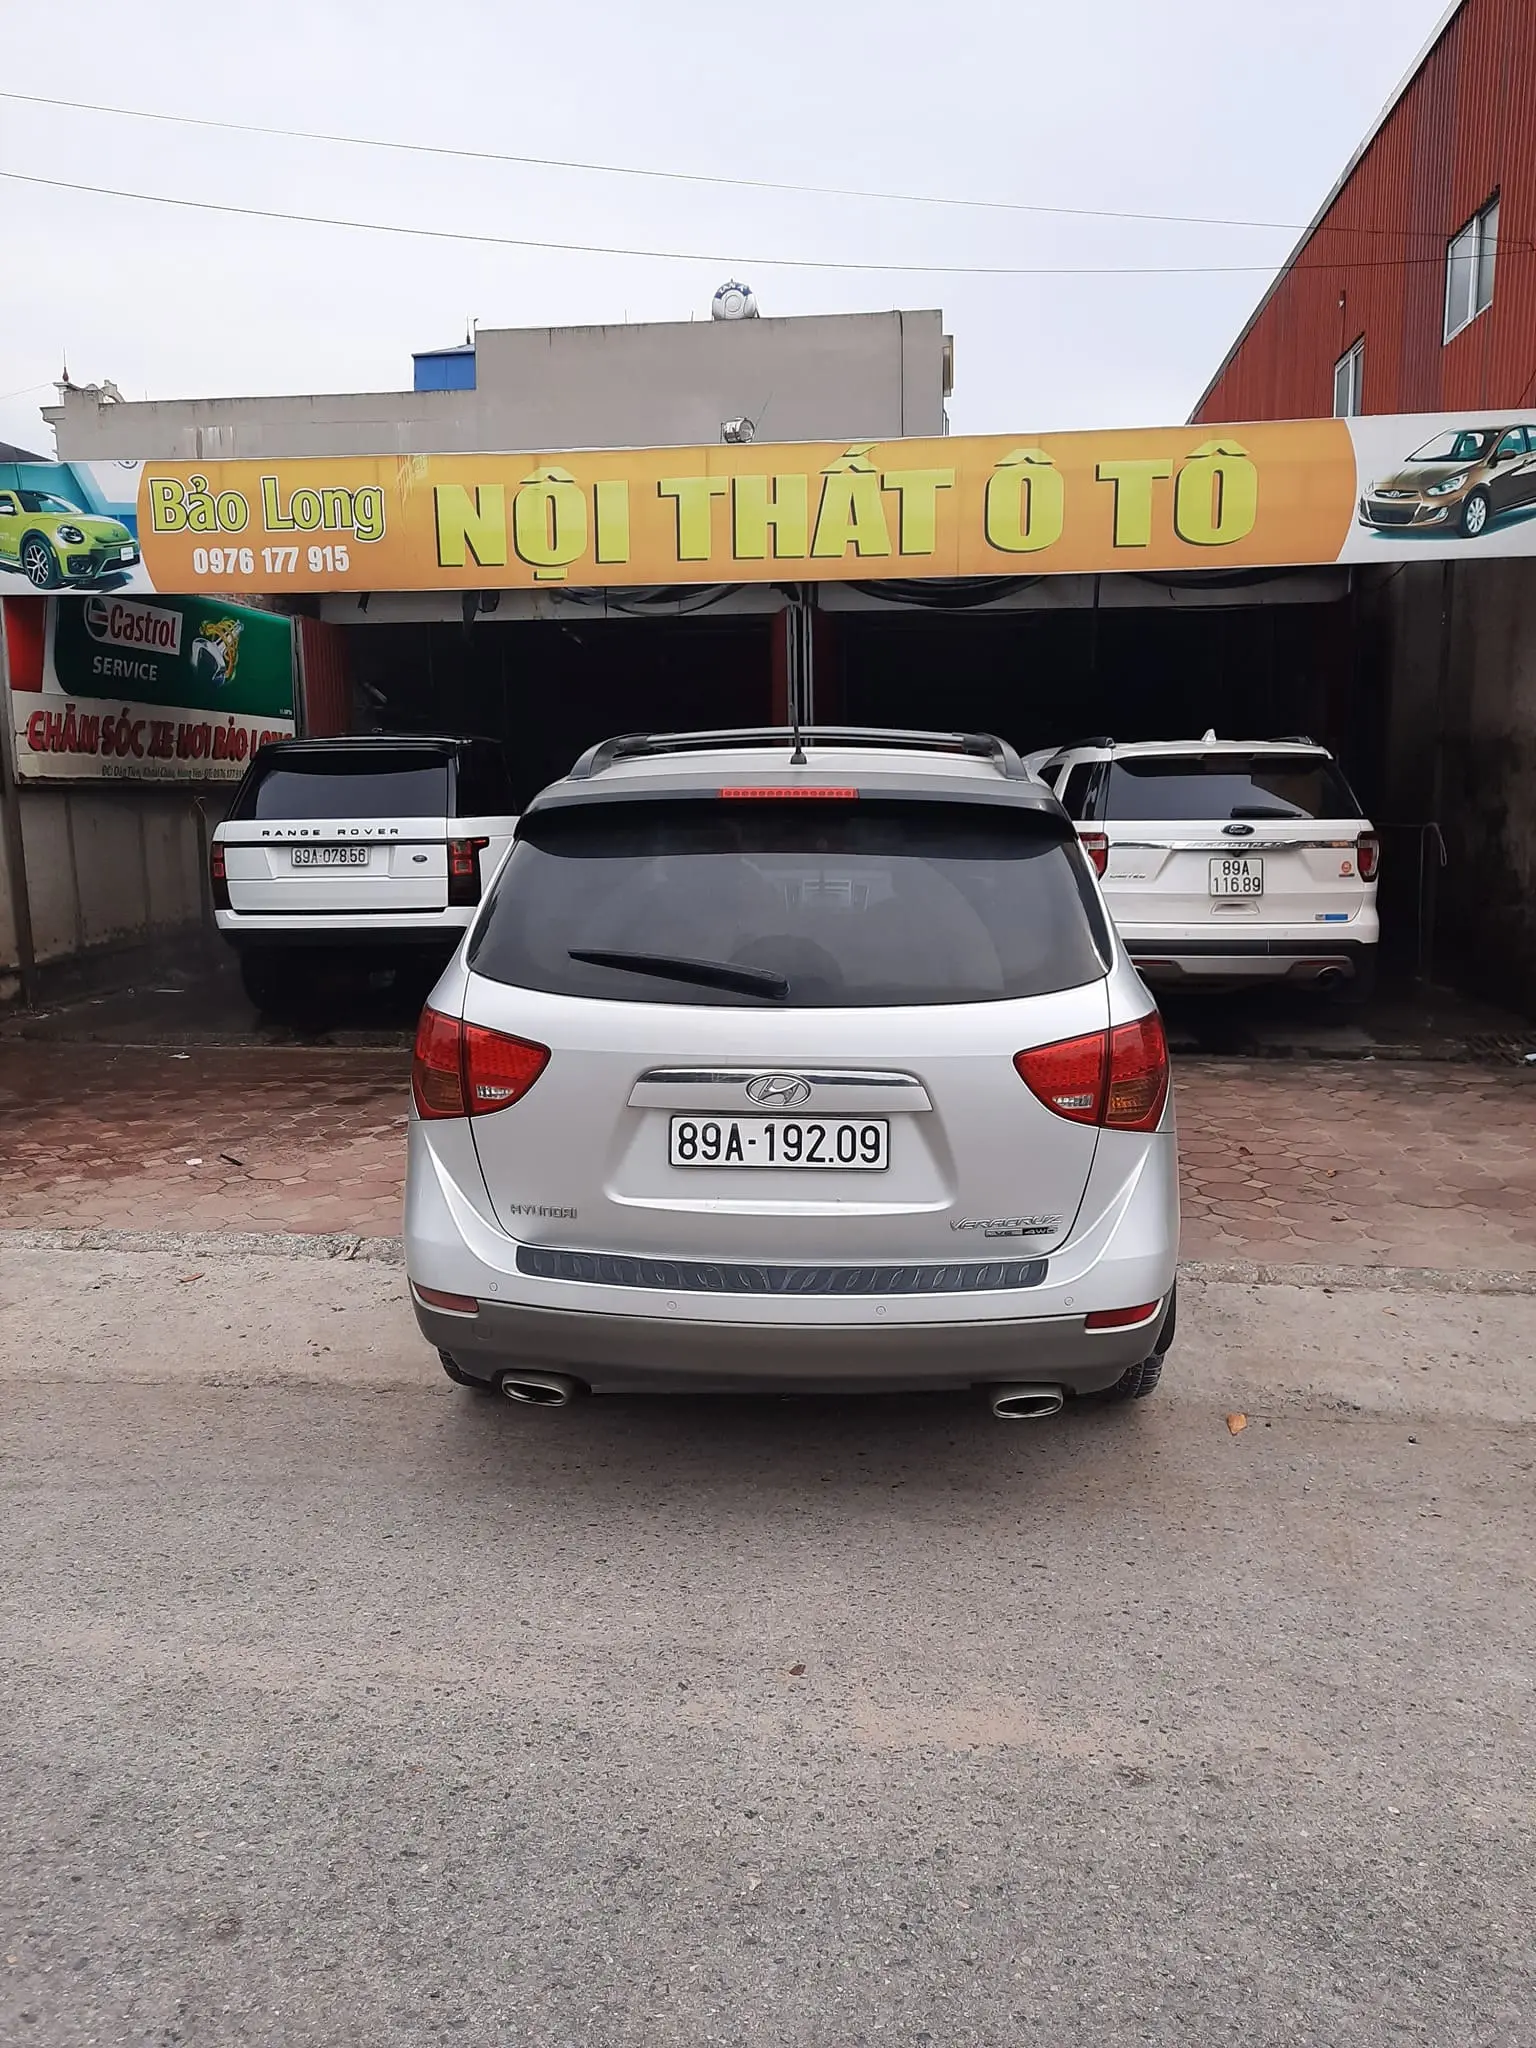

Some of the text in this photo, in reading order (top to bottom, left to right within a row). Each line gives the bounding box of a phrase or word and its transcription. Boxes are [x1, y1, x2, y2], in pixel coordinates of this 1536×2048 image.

[148, 474, 386, 543] Bảo Long
[435, 438, 1258, 581] NỘI THẤT Ô TÔ
[193, 545, 350, 574] 0976 177 915
[110, 604, 177, 649] Castrol
[92, 655, 159, 682] SERVICE
[26, 703, 99, 754] CHĂM
[101, 707, 146, 759] SÓC
[211, 716, 248, 762] BẢO
[262, 828, 400, 837] RANGE ROVER
[294, 848, 367, 865] 89A-078.56
[1222, 860, 1250, 876] 89A
[1213, 876, 1261, 893] 116.89
[677, 1121, 882, 1164] 89A-192.09
[510, 1203, 578, 1219] HYUNDAI
